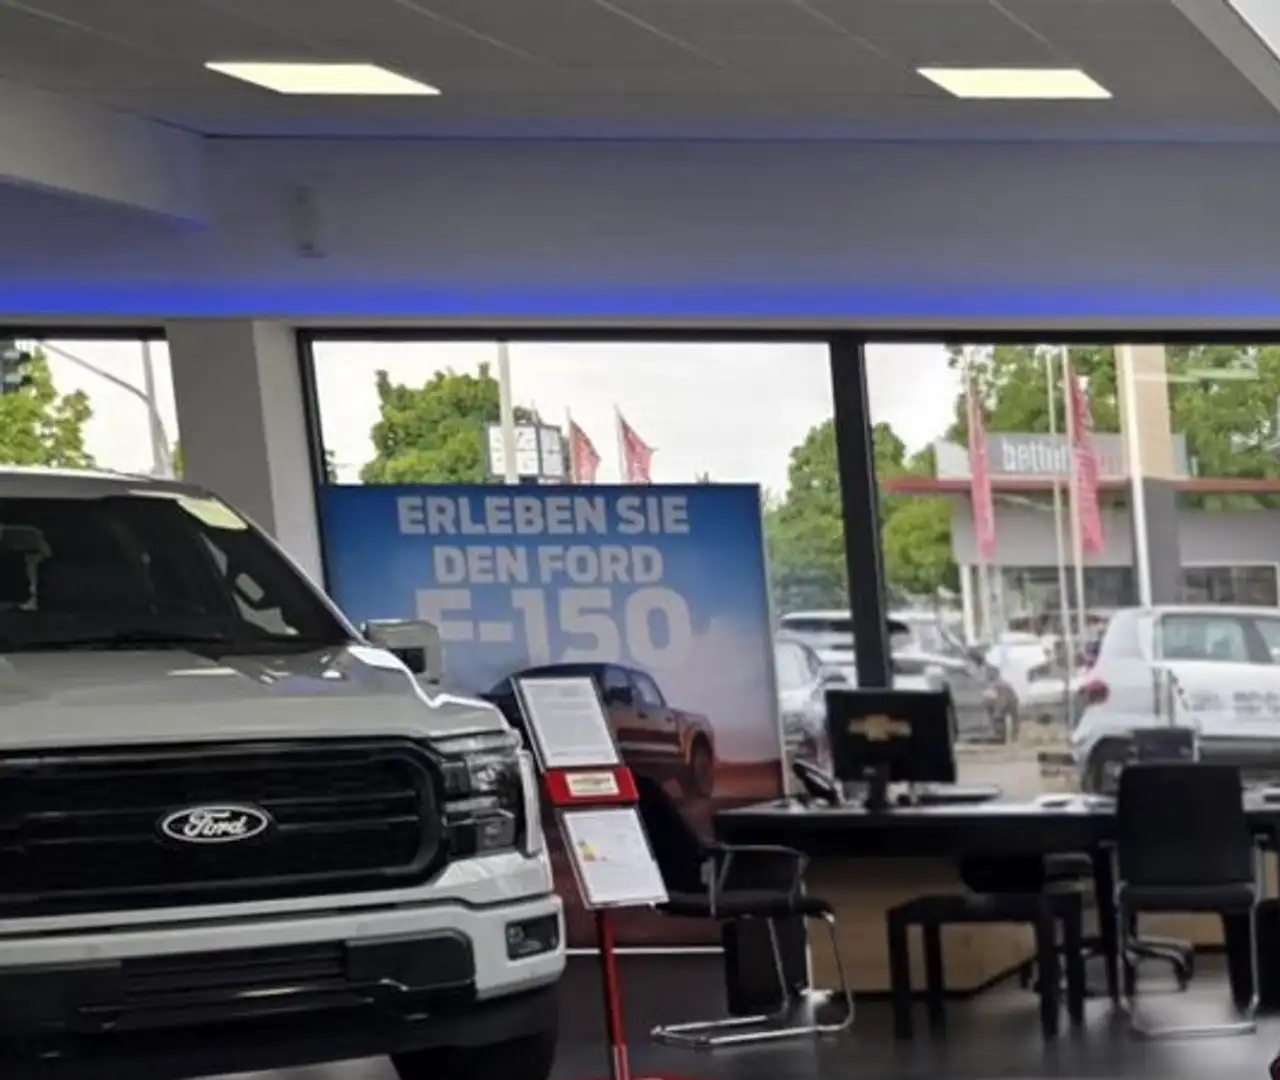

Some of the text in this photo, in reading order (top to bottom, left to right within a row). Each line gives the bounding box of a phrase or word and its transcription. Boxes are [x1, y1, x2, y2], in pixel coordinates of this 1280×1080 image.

[396, 496, 690, 534] ERLEBEN SIE
[433, 545, 664, 584] DEN FORD
[415, 587, 692, 668] F-150
[182, 808, 249, 838] Ford
